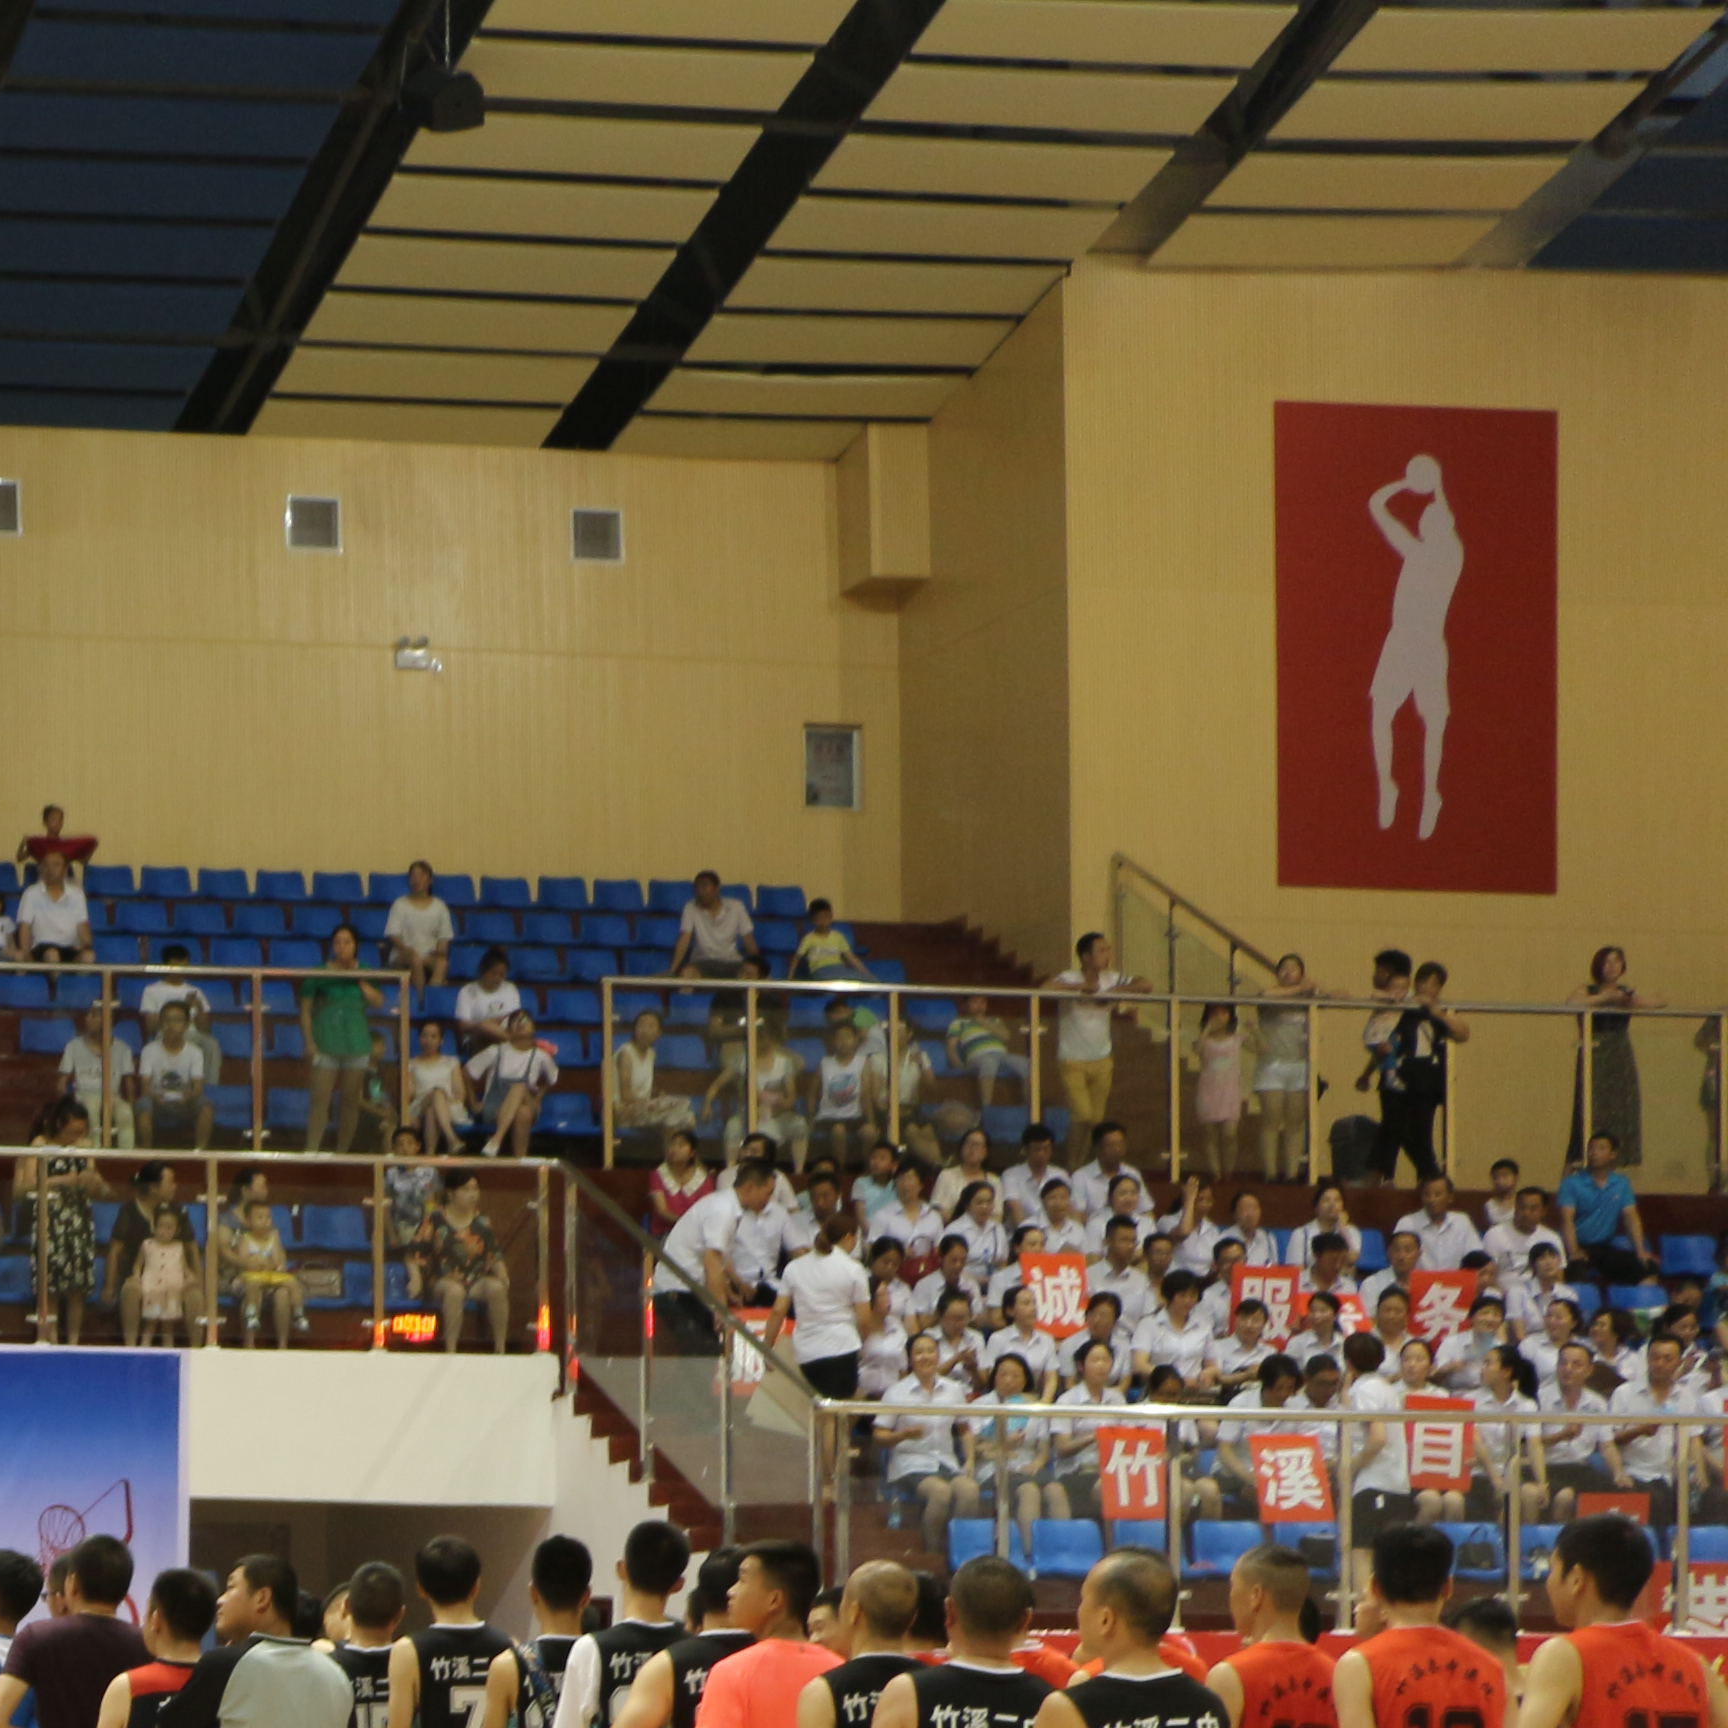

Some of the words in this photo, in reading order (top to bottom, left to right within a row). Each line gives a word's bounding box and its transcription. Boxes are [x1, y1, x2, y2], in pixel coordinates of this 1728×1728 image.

[1032, 1266, 1087, 1328] 诚
[1240, 1276, 1294, 1340] 服
[1415, 1282, 1468, 1341] 务
[1105, 1438, 1164, 1507] 竹
[1259, 1446, 1326, 1511] 溪
